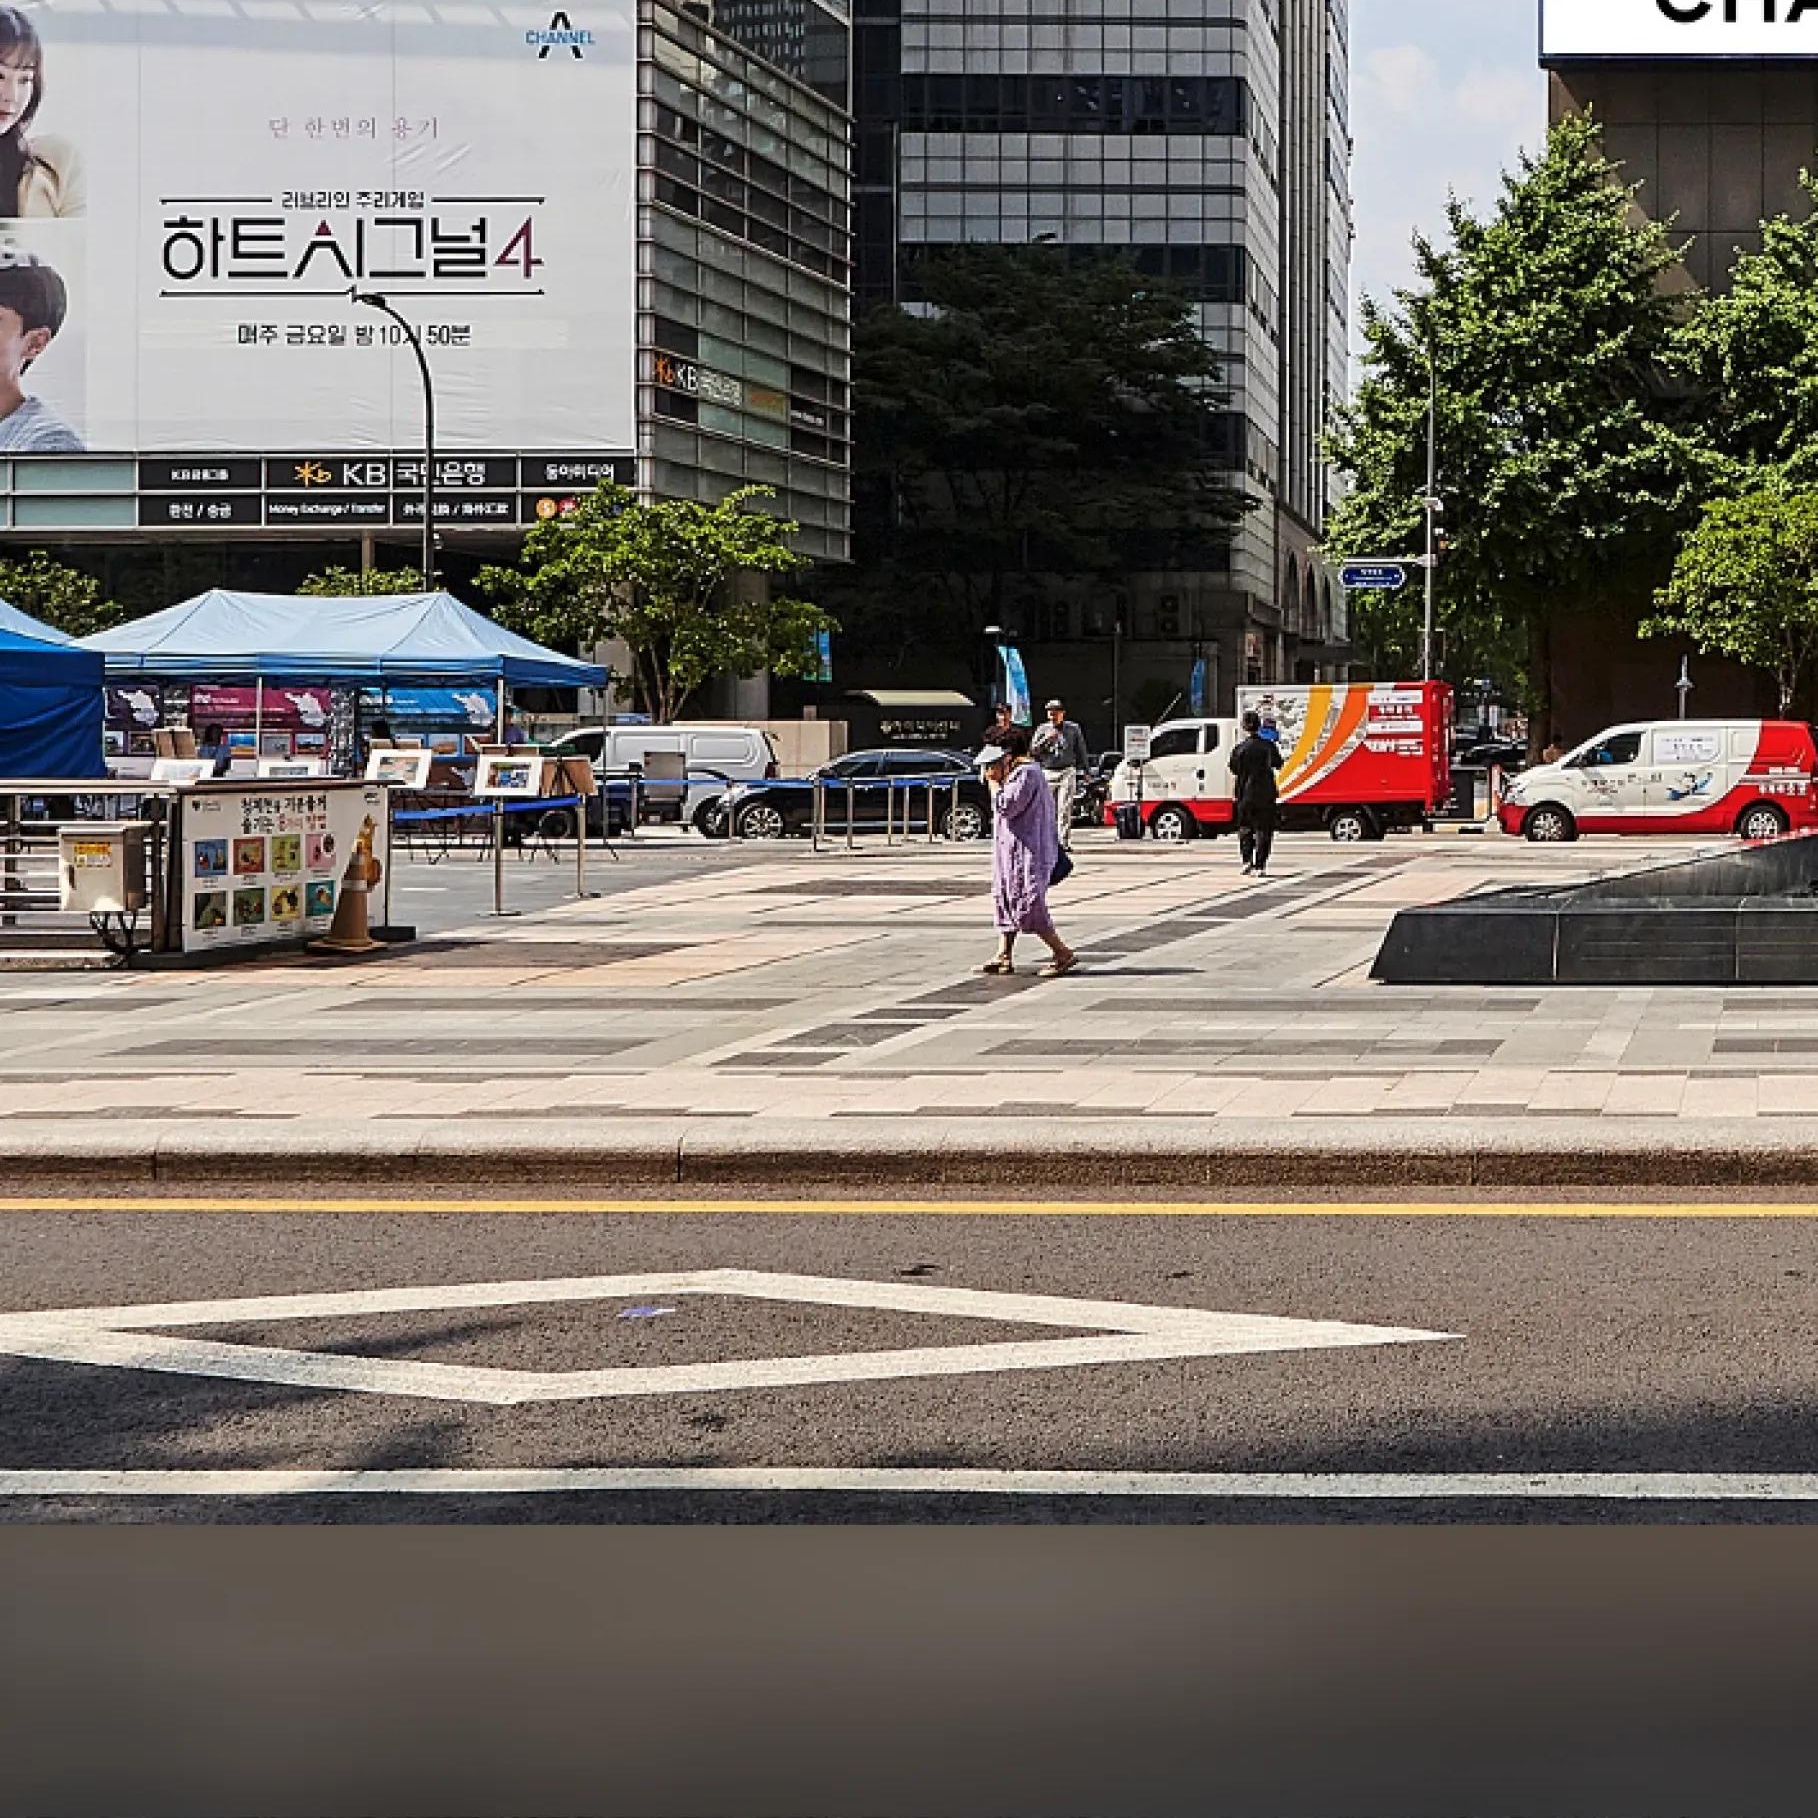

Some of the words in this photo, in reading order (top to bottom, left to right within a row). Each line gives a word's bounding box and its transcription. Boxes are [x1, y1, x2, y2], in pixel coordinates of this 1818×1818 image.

[525, 29, 595, 45] CHANNEL
[269, 117, 289, 139] 단
[304, 117, 376, 139] 한번의
[391, 117, 437, 139] 용기
[281, 191, 350, 210] 러브라인
[356, 191, 425, 210] 추리게임
[238, 325, 278, 346] 매주
[286, 325, 347, 346] 금요일
[356, 325, 374, 346] 밤
[426, 325, 471, 346] 50분
[677, 362, 698, 391] KB
[343, 462, 387, 485] KB
[397, 461, 486, 486] 국민은행
[268, 502, 299, 517] Money
